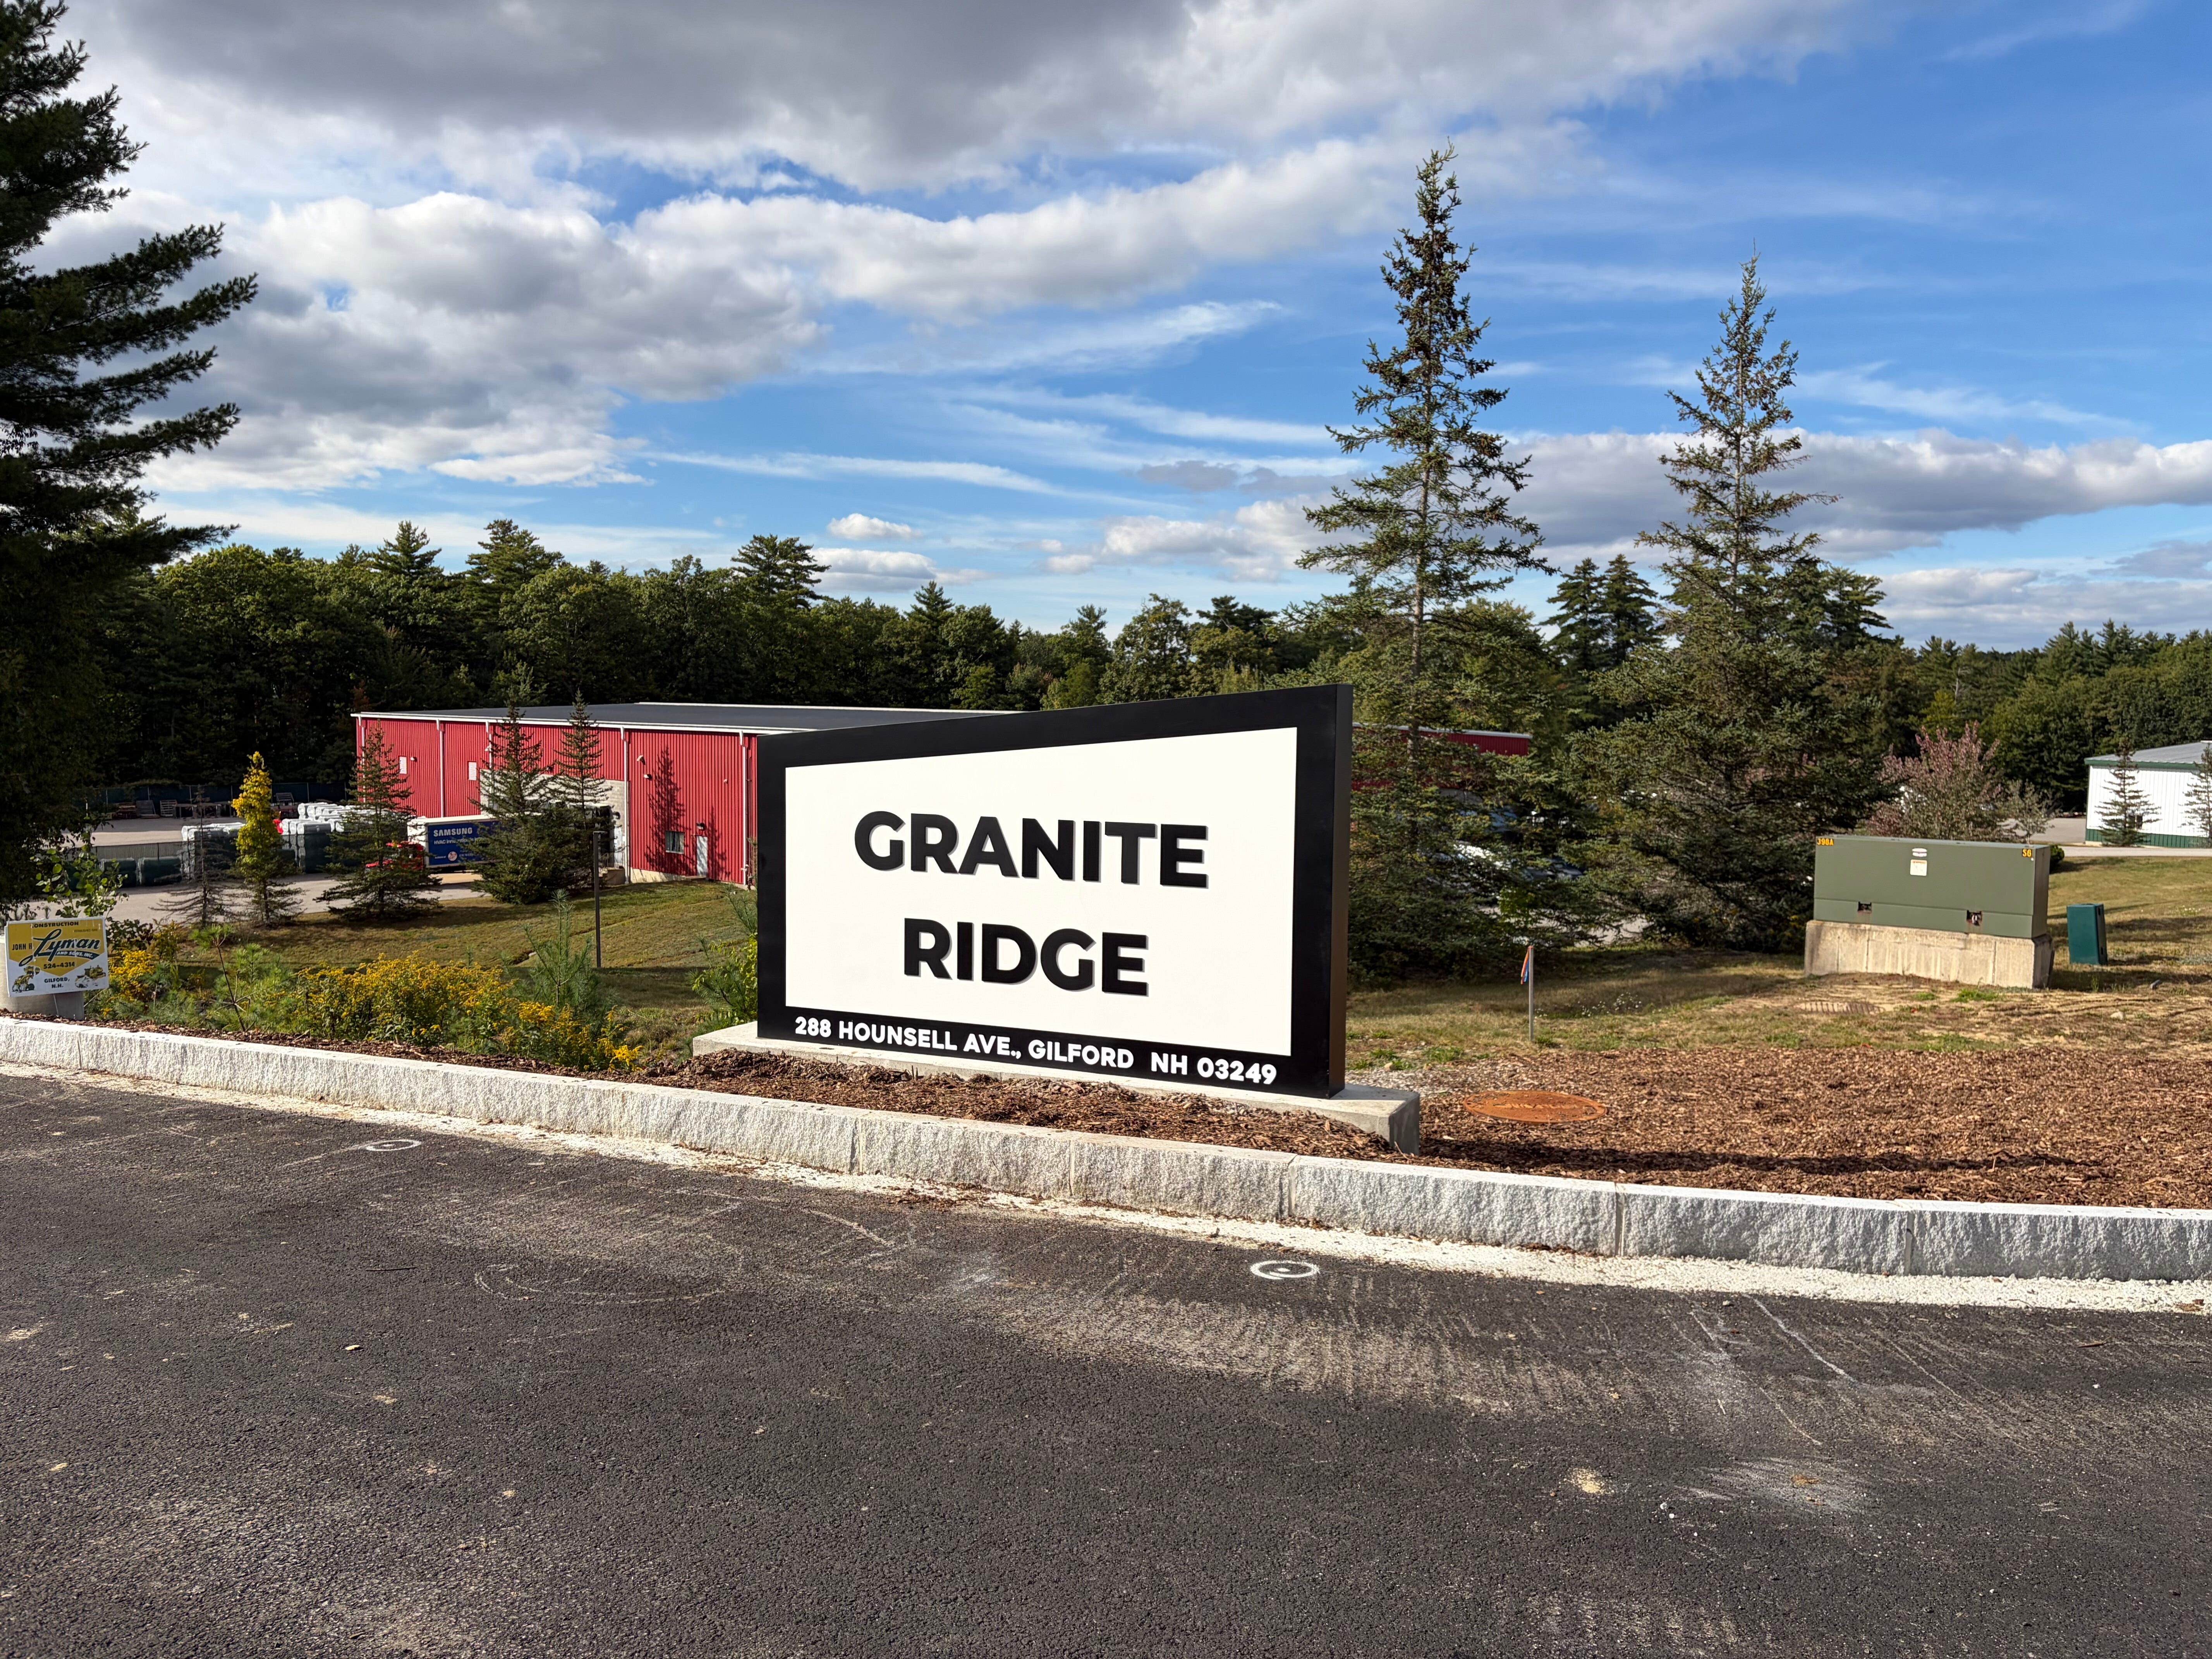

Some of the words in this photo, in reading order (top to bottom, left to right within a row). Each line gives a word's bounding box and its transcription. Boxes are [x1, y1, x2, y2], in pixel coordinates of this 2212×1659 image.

[433, 827, 472, 837] SAMSUNG
[855, 811, 1208, 889] GRANITE
[19, 929, 100, 967] Lyman
[904, 918, 1149, 996] RIDGE
[795, 1017, 831, 1037] 288
[839, 1021, 957, 1051] HOUNSELL
[963, 1033, 1021, 1059] AVE.,
[1029, 1039, 1134, 1068] GILFORD
[1151, 1052, 1187, 1075] NH
[1197, 1057, 1277, 1084] 03249
